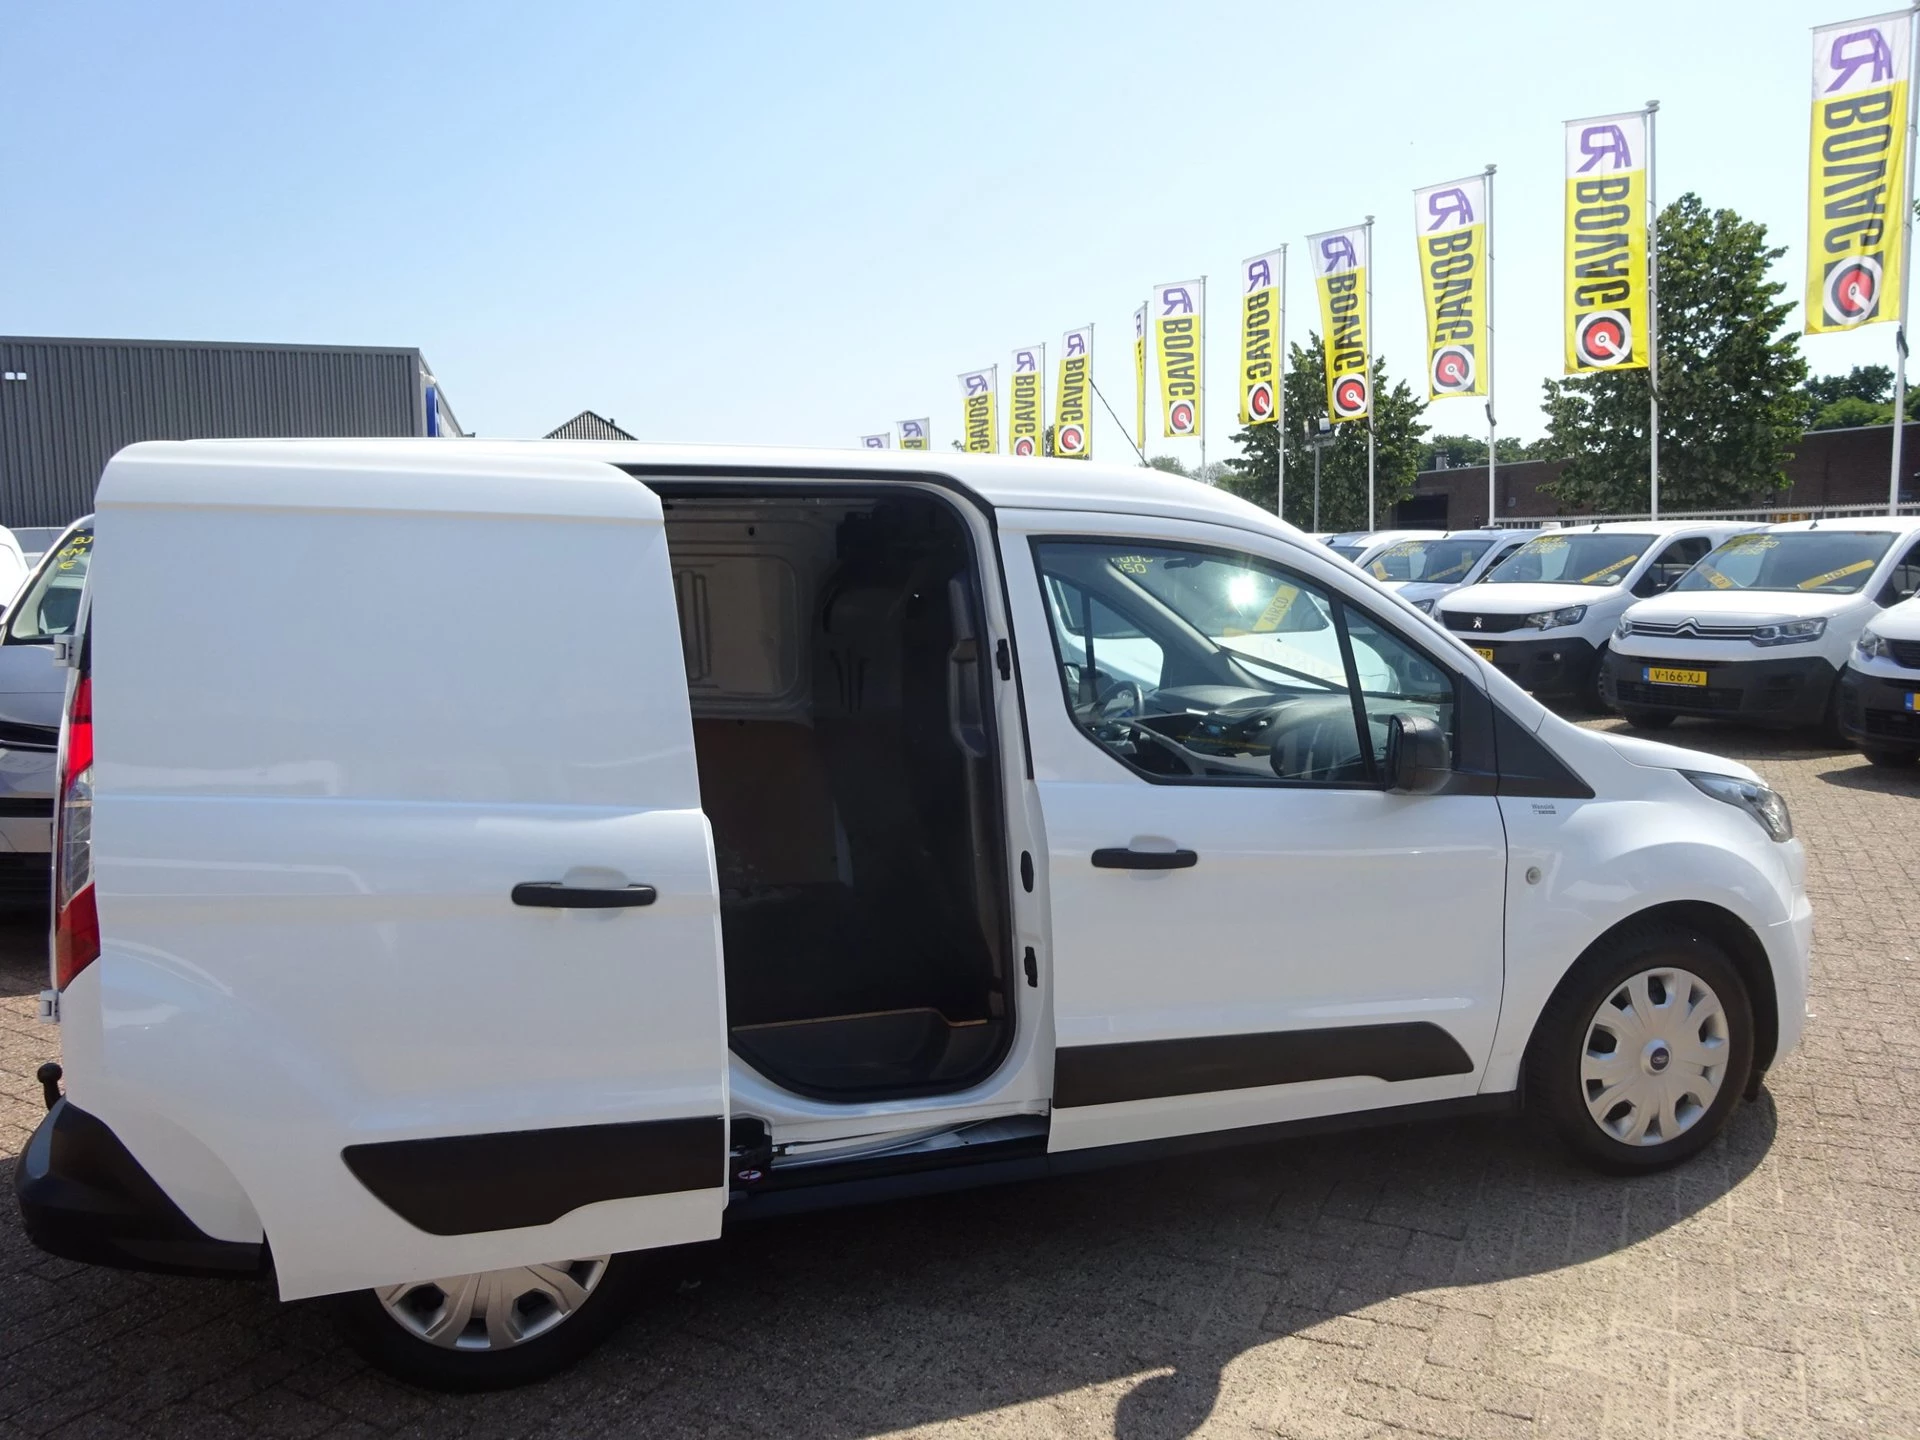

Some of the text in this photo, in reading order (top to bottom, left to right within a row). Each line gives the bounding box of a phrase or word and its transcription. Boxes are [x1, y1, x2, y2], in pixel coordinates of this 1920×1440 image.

[57, 547, 86, 557] KM
[1263, 596, 1289, 624] AIRCO
[1654, 670, 1700, 683] V-166-XJ
